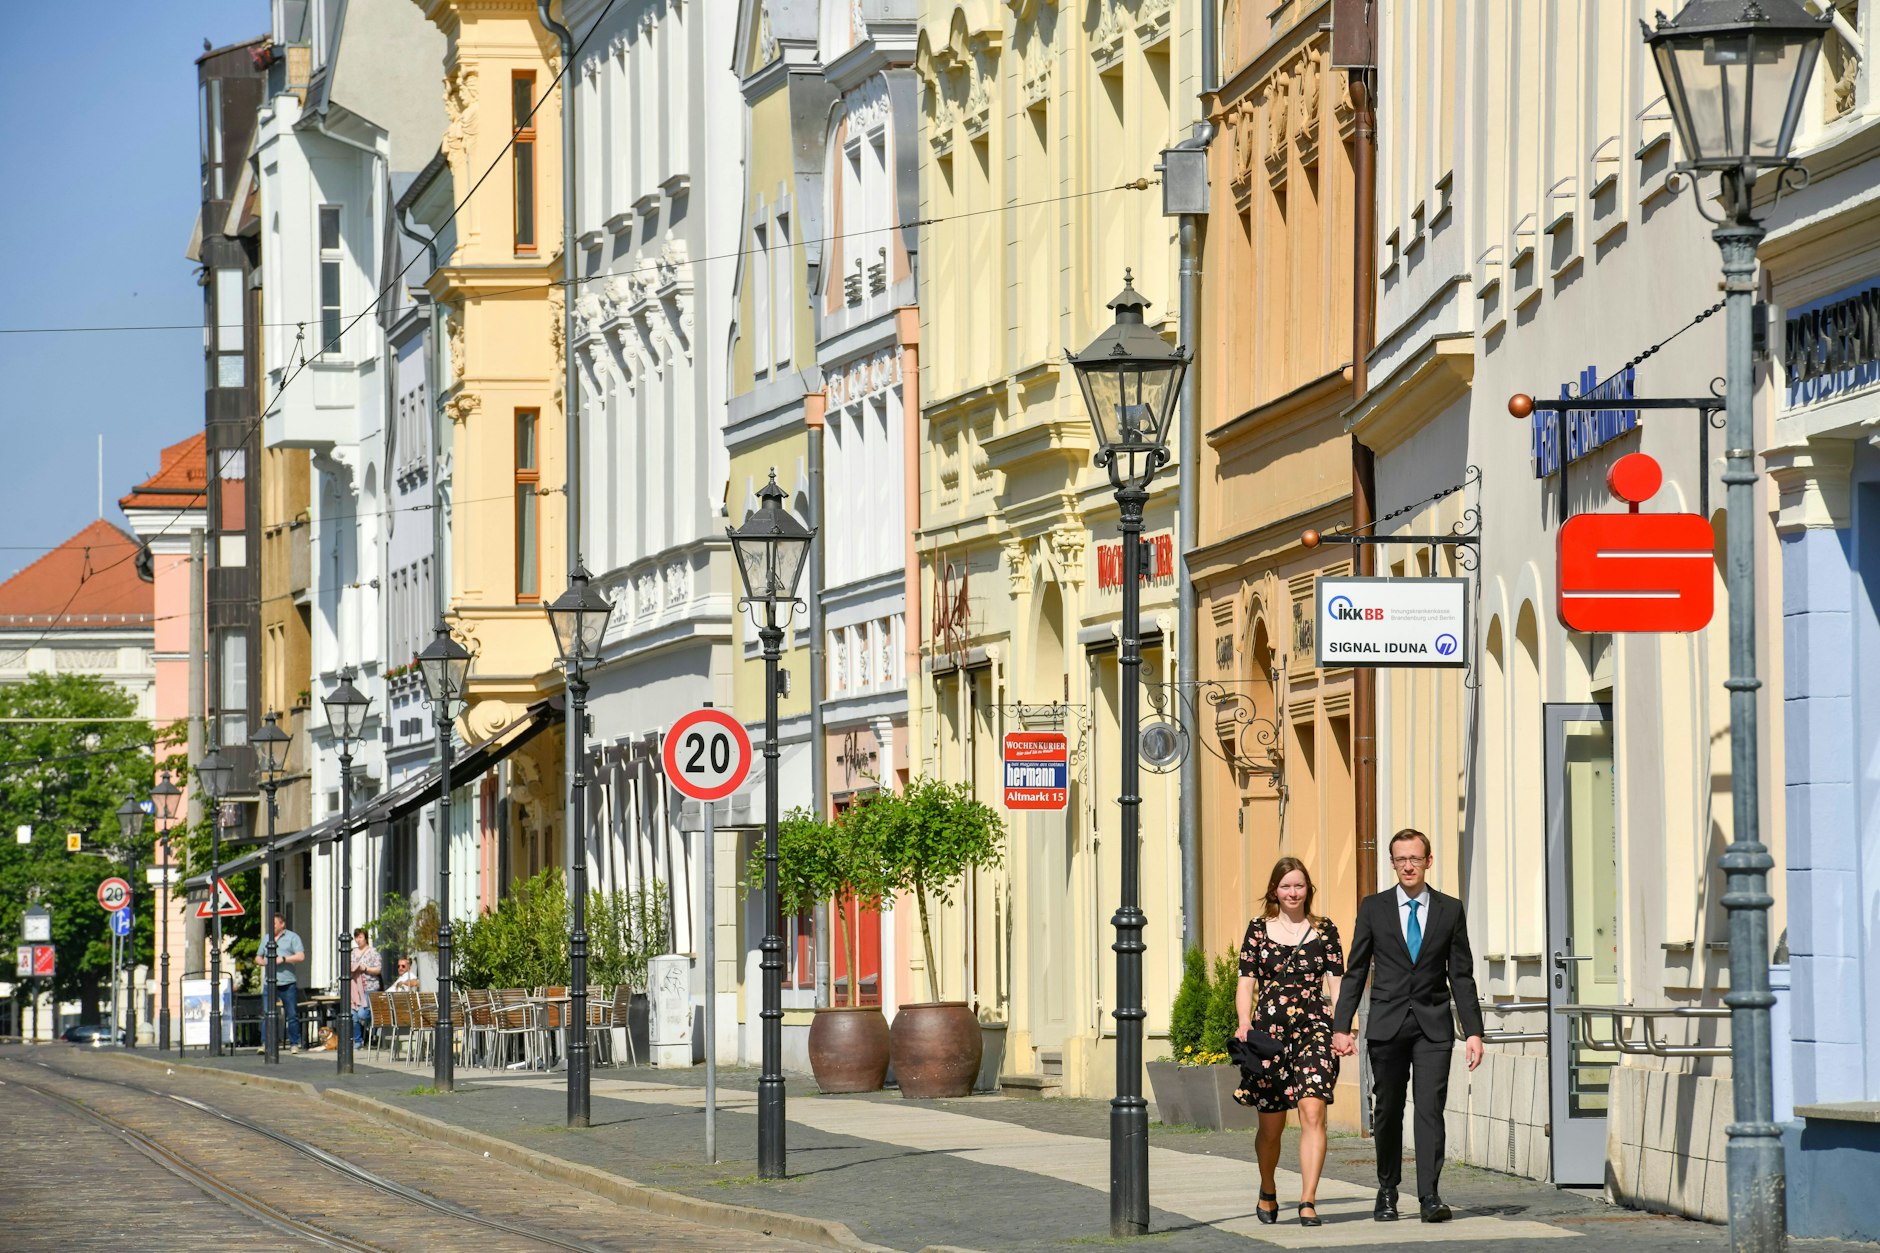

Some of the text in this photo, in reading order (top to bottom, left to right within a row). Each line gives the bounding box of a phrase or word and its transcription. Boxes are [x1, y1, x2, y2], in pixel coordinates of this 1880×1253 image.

[1329, 642, 1428, 654] SIGNAL IDUNA
[685, 732, 730, 774] 20
[1006, 763, 1056, 787] hermann
[1007, 791, 1064, 802] Altmarkt 15
[105, 887, 123, 902] 20
